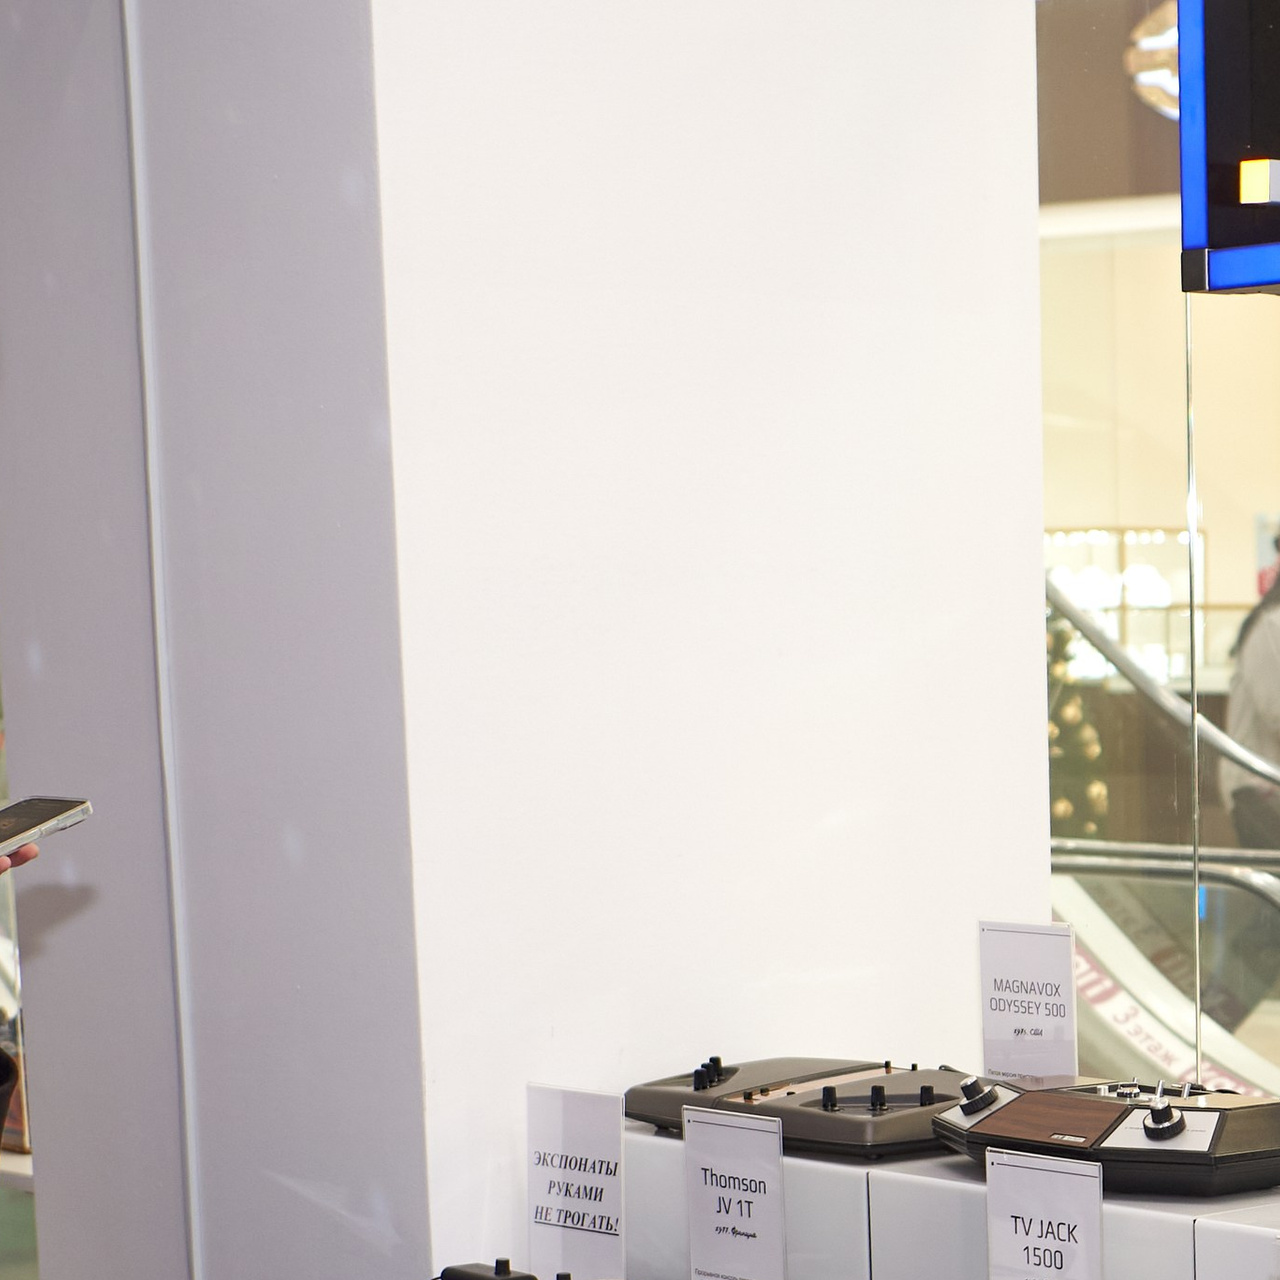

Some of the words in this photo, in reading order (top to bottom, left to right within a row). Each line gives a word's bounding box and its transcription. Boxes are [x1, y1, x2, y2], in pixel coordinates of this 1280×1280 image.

[993, 978, 1061, 997] MAGNAVOX
[989, 997, 1041, 1015] ODYSSEY
[1044, 1003, 1066, 1018] 500
[1112, 1004, 1139, 1026] 3
[1125, 1026, 1181, 1068] этаж
[533, 1150, 619, 1177] ЭКСПОНАТЫ
[547, 1179, 604, 1203] РУКАМИ
[701, 1167, 767, 1194] Thomson
[534, 1205, 553, 1222] НЕ
[556, 1207, 620, 1233] ТРОГАТЬ!
[716, 1195, 732, 1216] JV
[736, 1199, 753, 1218] 1T
[1010, 1215, 1033, 1237] TV
[1037, 1220, 1078, 1244] JACK
[1023, 1245, 1064, 1270] 1500
